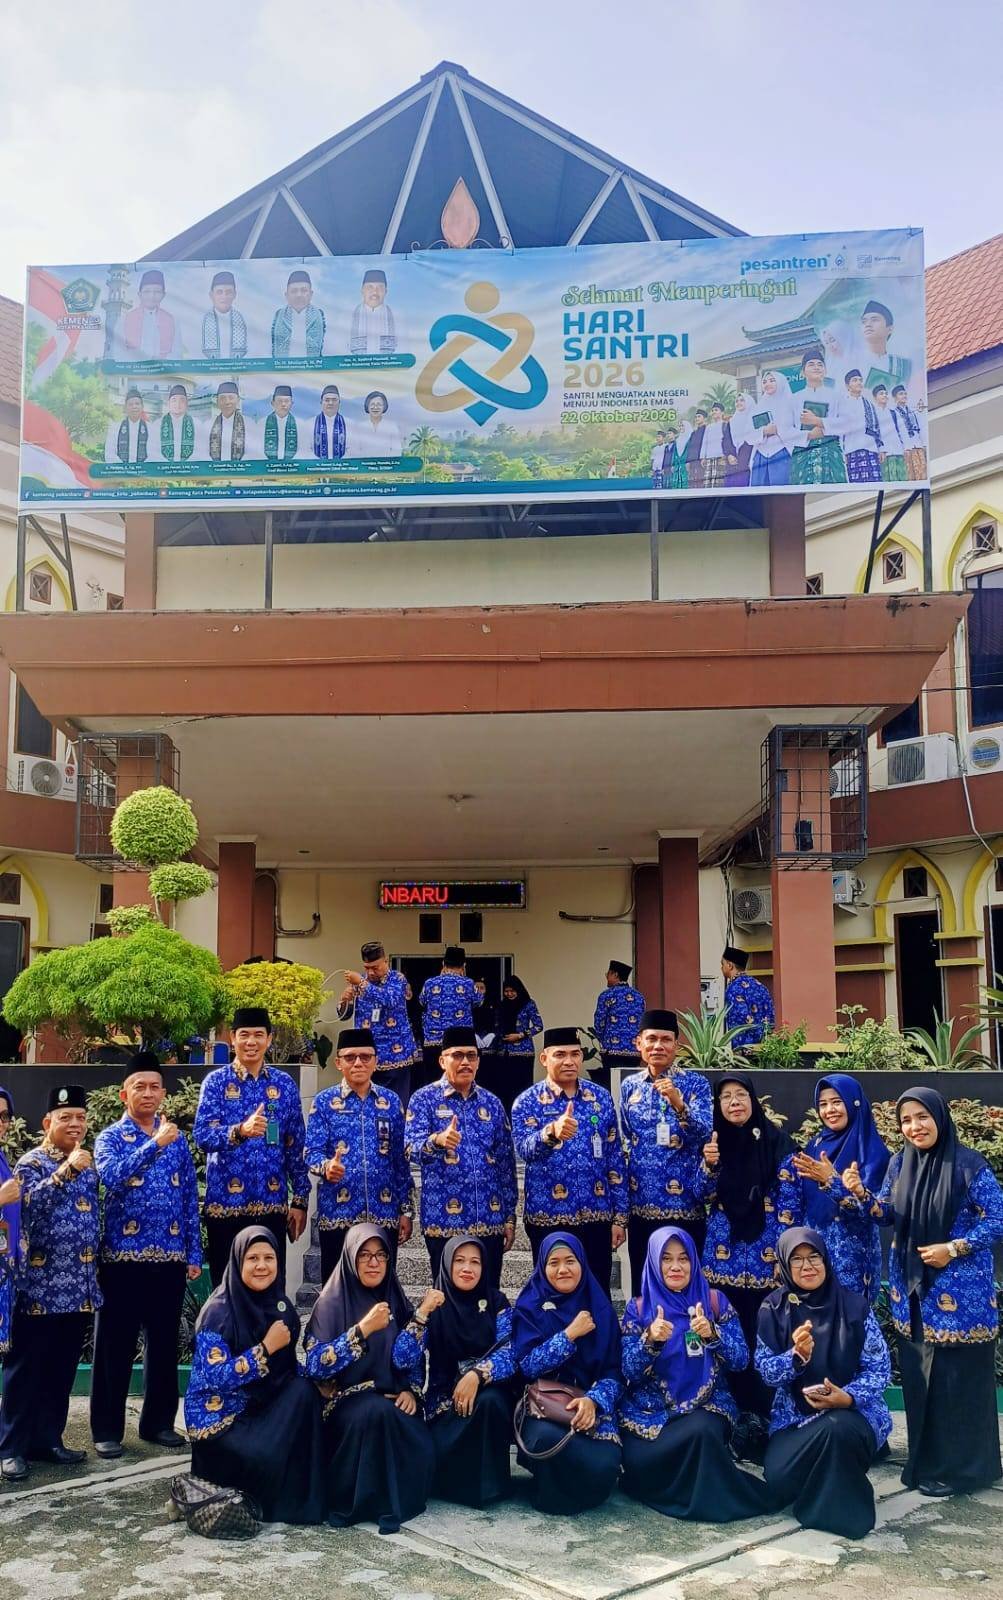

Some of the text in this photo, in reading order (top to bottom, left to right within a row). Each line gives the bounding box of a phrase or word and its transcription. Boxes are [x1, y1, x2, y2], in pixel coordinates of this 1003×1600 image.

[740, 256, 828, 275] pesantren
[561, 277, 797, 307] Selamat Memperingati
[563, 309, 645, 335] HARI
[563, 333, 689, 361] SANTRI
[563, 362, 646, 388] 2026
[563, 389, 689, 400] SANTRI MENGUATKAN NEGERI
[563, 398, 675, 408] MENUJU INDONESIA EMAS
[560, 408, 677, 424] 22 Oktober 2026
[383, 887, 449, 903] NBARU
